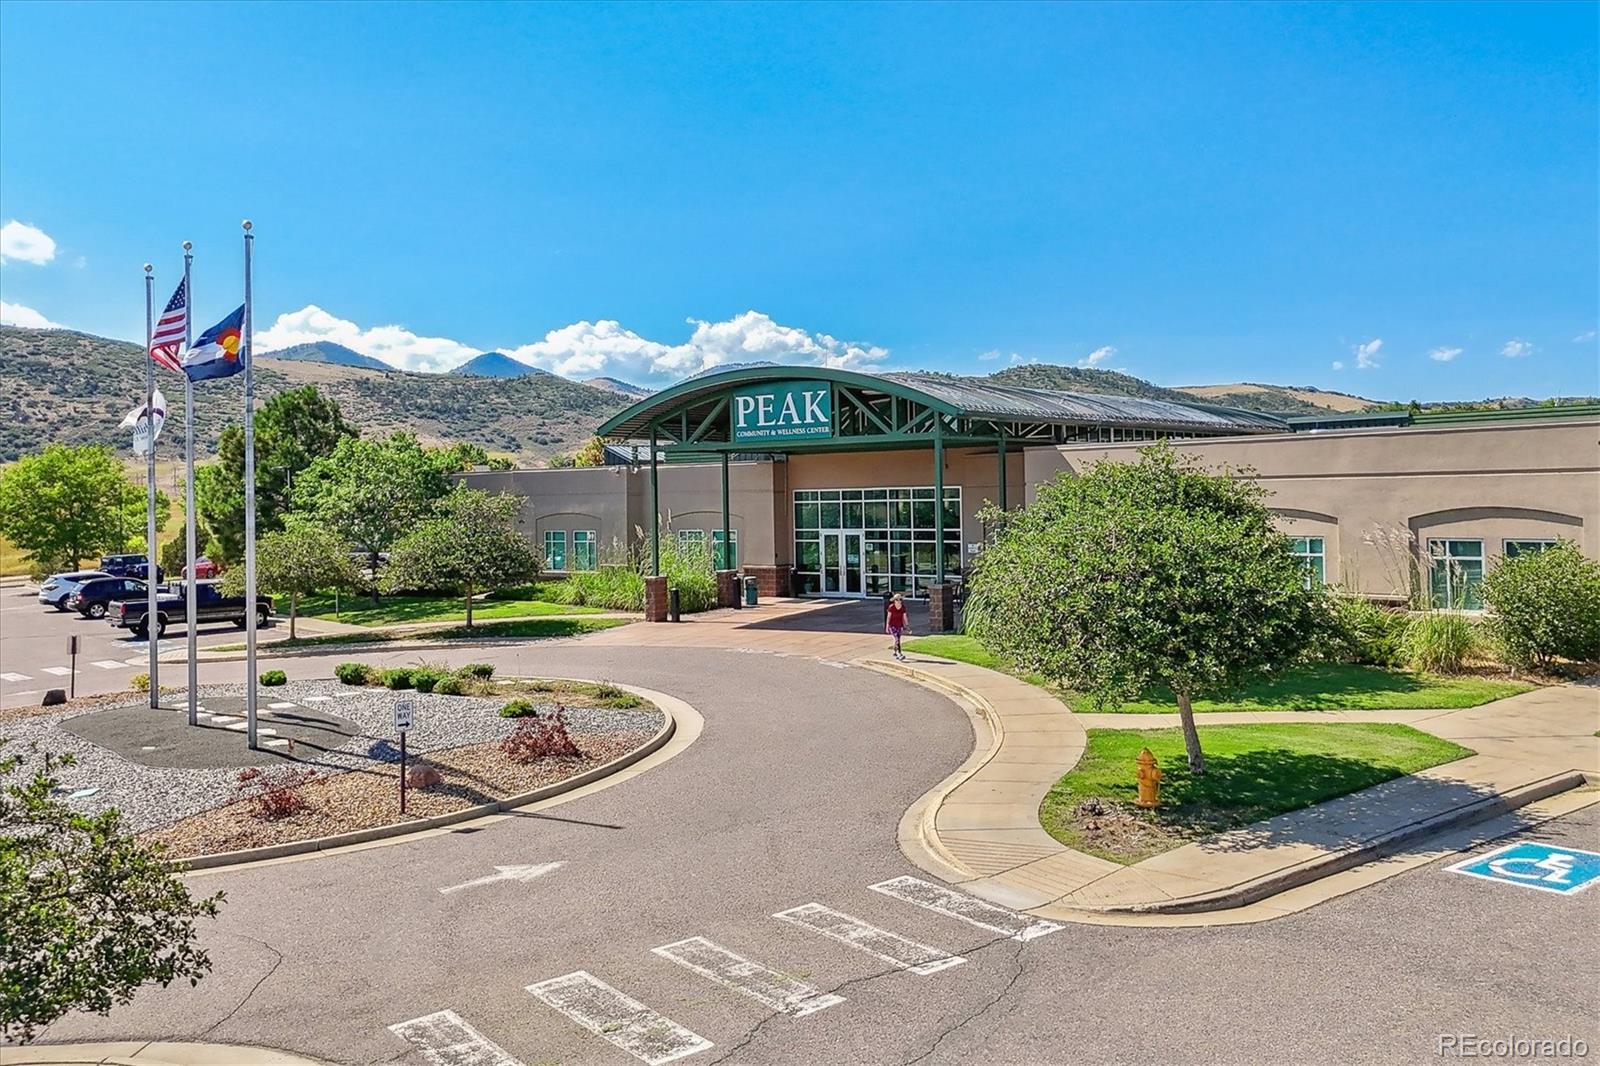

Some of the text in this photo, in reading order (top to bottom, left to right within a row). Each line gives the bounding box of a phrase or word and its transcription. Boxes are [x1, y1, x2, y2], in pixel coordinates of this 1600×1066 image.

[735, 390, 829, 427] PEAK
[736, 429, 770, 437] COMMUNITY
[777, 427, 806, 435] WELLNESS
[398, 703, 410, 711] ONE
[398, 712, 410, 720] WAY
